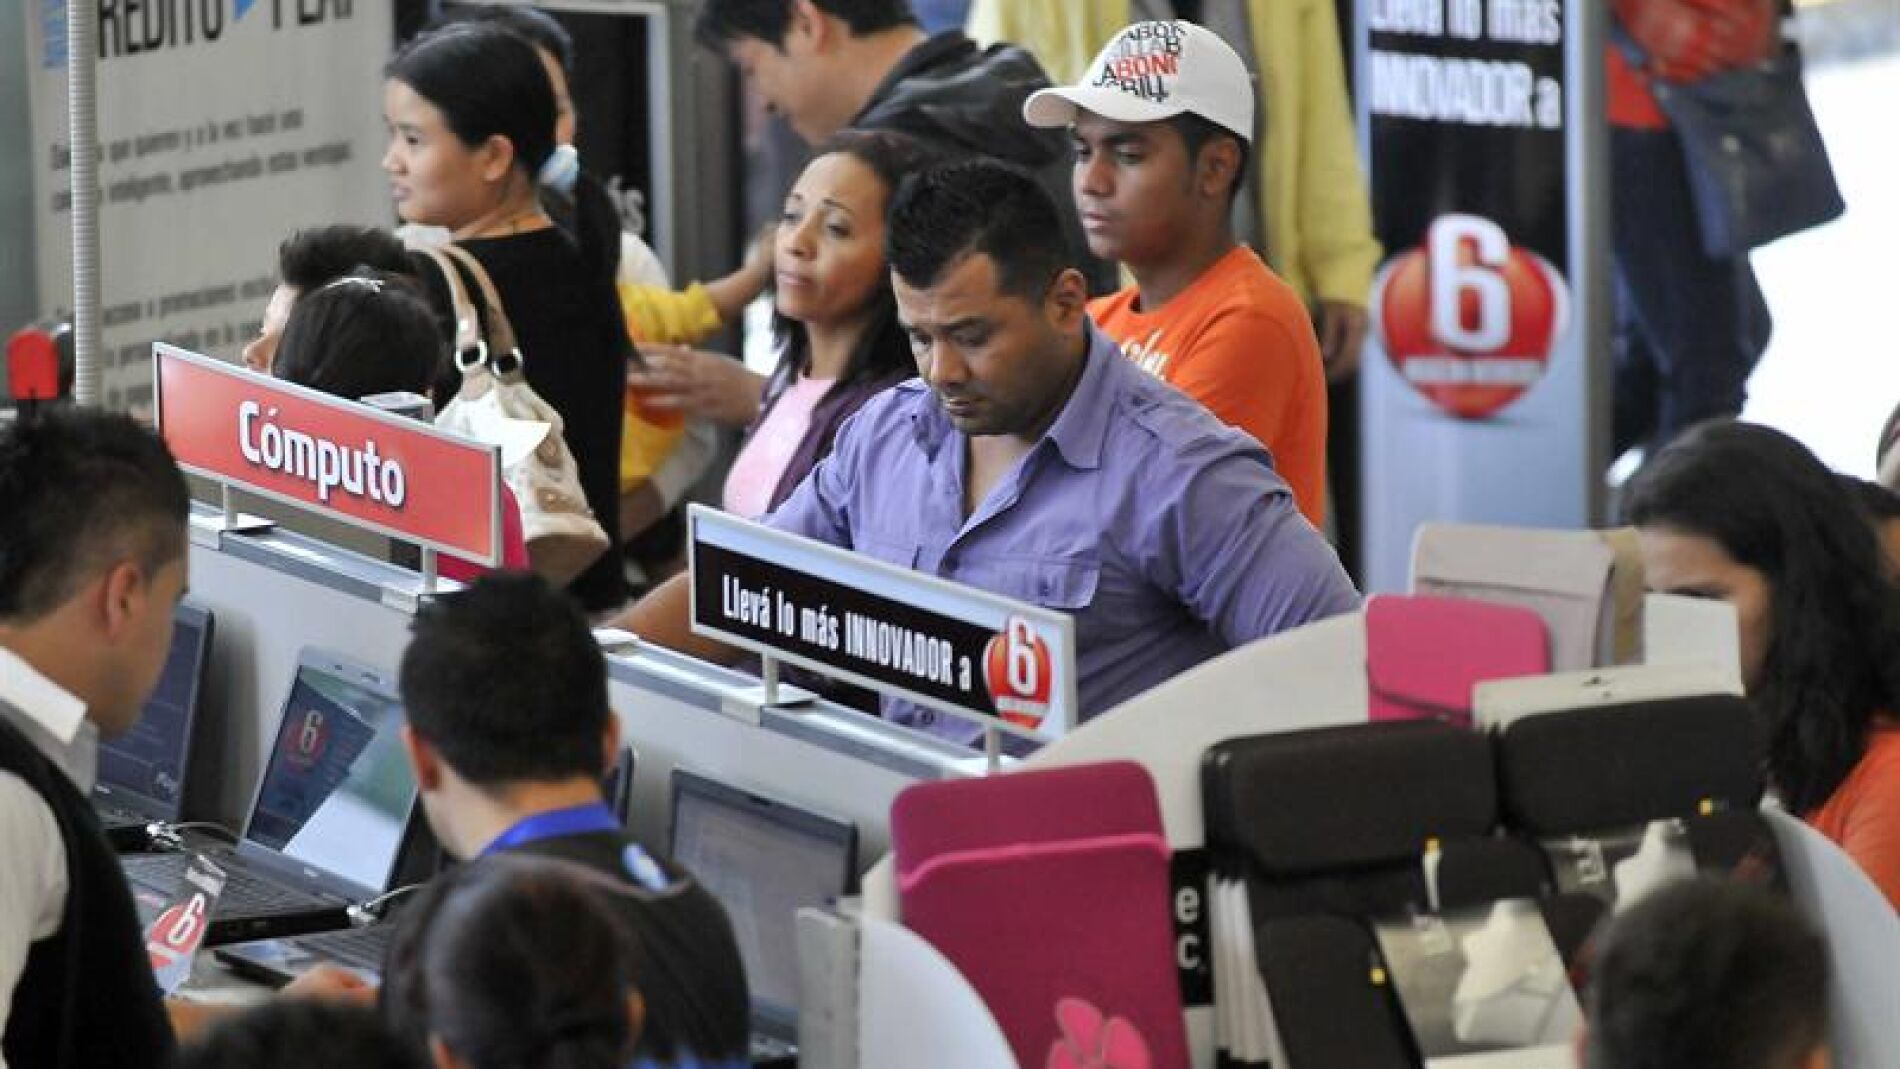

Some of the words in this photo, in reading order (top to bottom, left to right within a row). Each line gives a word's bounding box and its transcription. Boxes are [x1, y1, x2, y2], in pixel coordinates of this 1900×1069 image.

[98, 0, 224, 58] REDI
[1429, 213, 1512, 353] 6
[239, 400, 406, 508] Cómputo
[722, 574, 771, 629] Llevá
[776, 591, 794, 637] lo
[802, 605, 839, 650] más
[845, 611, 953, 686] INNOVADOR
[959, 655, 972, 692] a
[1008, 613, 1037, 697] 6
[167, 892, 205, 944] 6
